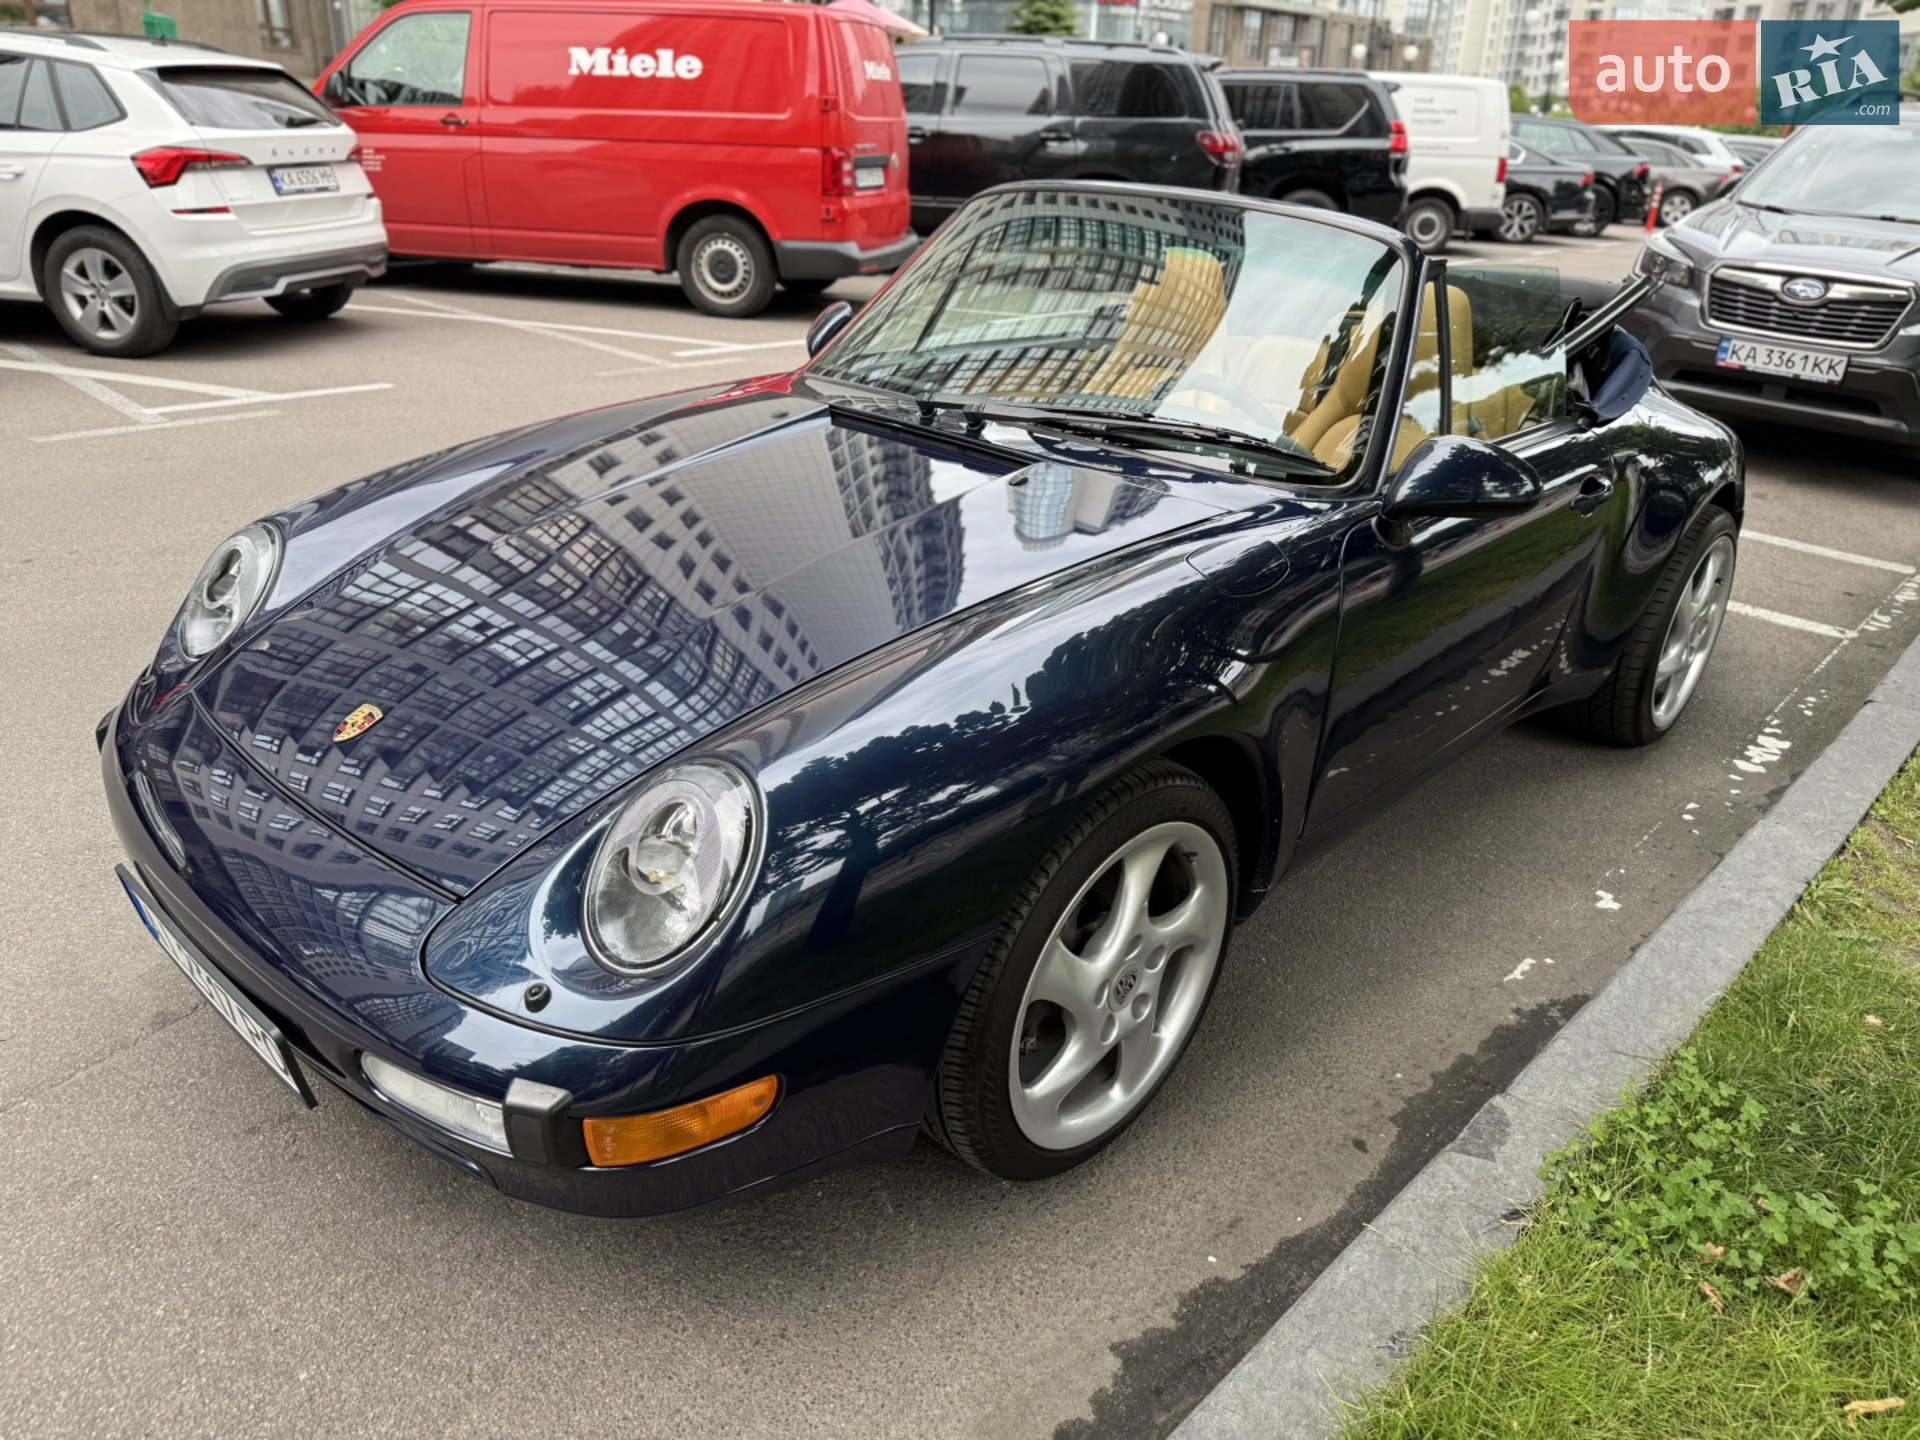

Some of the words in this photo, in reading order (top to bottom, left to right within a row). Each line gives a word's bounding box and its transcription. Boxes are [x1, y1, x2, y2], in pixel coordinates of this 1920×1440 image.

[568, 47, 703, 80] Miele
[863, 60, 892, 82] Miele
[1729, 343, 1757, 364] KA
[1762, 347, 1809, 372] 3361
[1811, 355, 1845, 378] KK
